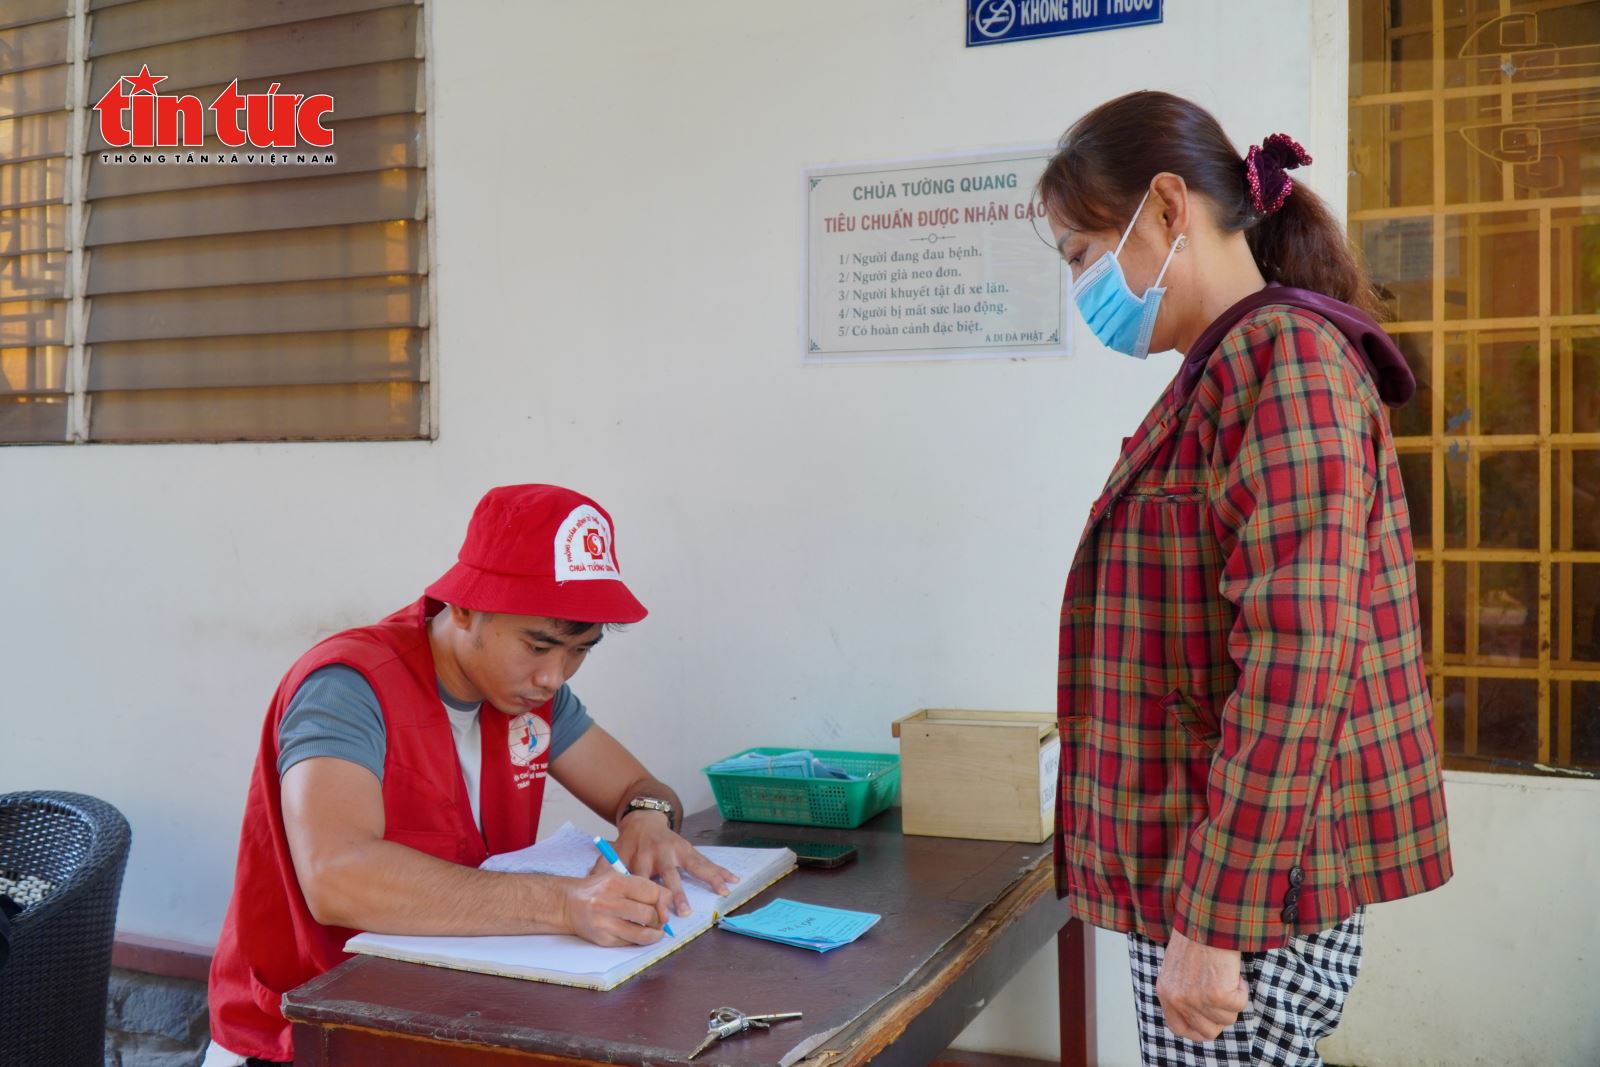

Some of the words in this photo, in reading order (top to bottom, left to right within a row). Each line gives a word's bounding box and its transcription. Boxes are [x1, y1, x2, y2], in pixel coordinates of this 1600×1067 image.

[902, 178, 954, 198] TƯỜNG
[960, 173, 1017, 193] QUANG
[824, 213, 856, 233] TIÊU
[861, 208, 913, 231] CHUẨN
[917, 206, 959, 228] ĐƯỢC
[965, 202, 1009, 225] NHẬN
[852, 251, 887, 267] Người
[948, 246, 983, 260] bệnh.
[838, 271, 850, 283] 2/
[852, 270, 887, 285] Người
[890, 269, 908, 283] già
[936, 267, 962, 278] đơn.
[838, 290, 850, 301] 3/
[852, 288, 887, 303] Người
[890, 286, 930, 300] khuyết
[934, 285, 950, 299] tật
[969, 285, 983, 294] xe
[838, 308, 850, 319] 4/
[852, 306, 887, 321] Người
[890, 305, 902, 319] bị
[905, 304, 927, 316] mất
[930, 302, 950, 315] sức
[953, 302, 971, 314] lao
[974, 300, 1008, 315] động.
[838, 326, 850, 337] 5/
[871, 324, 899, 336] hoàn
[902, 322, 930, 335] cảnh
[956, 320, 983, 334] biệt.
